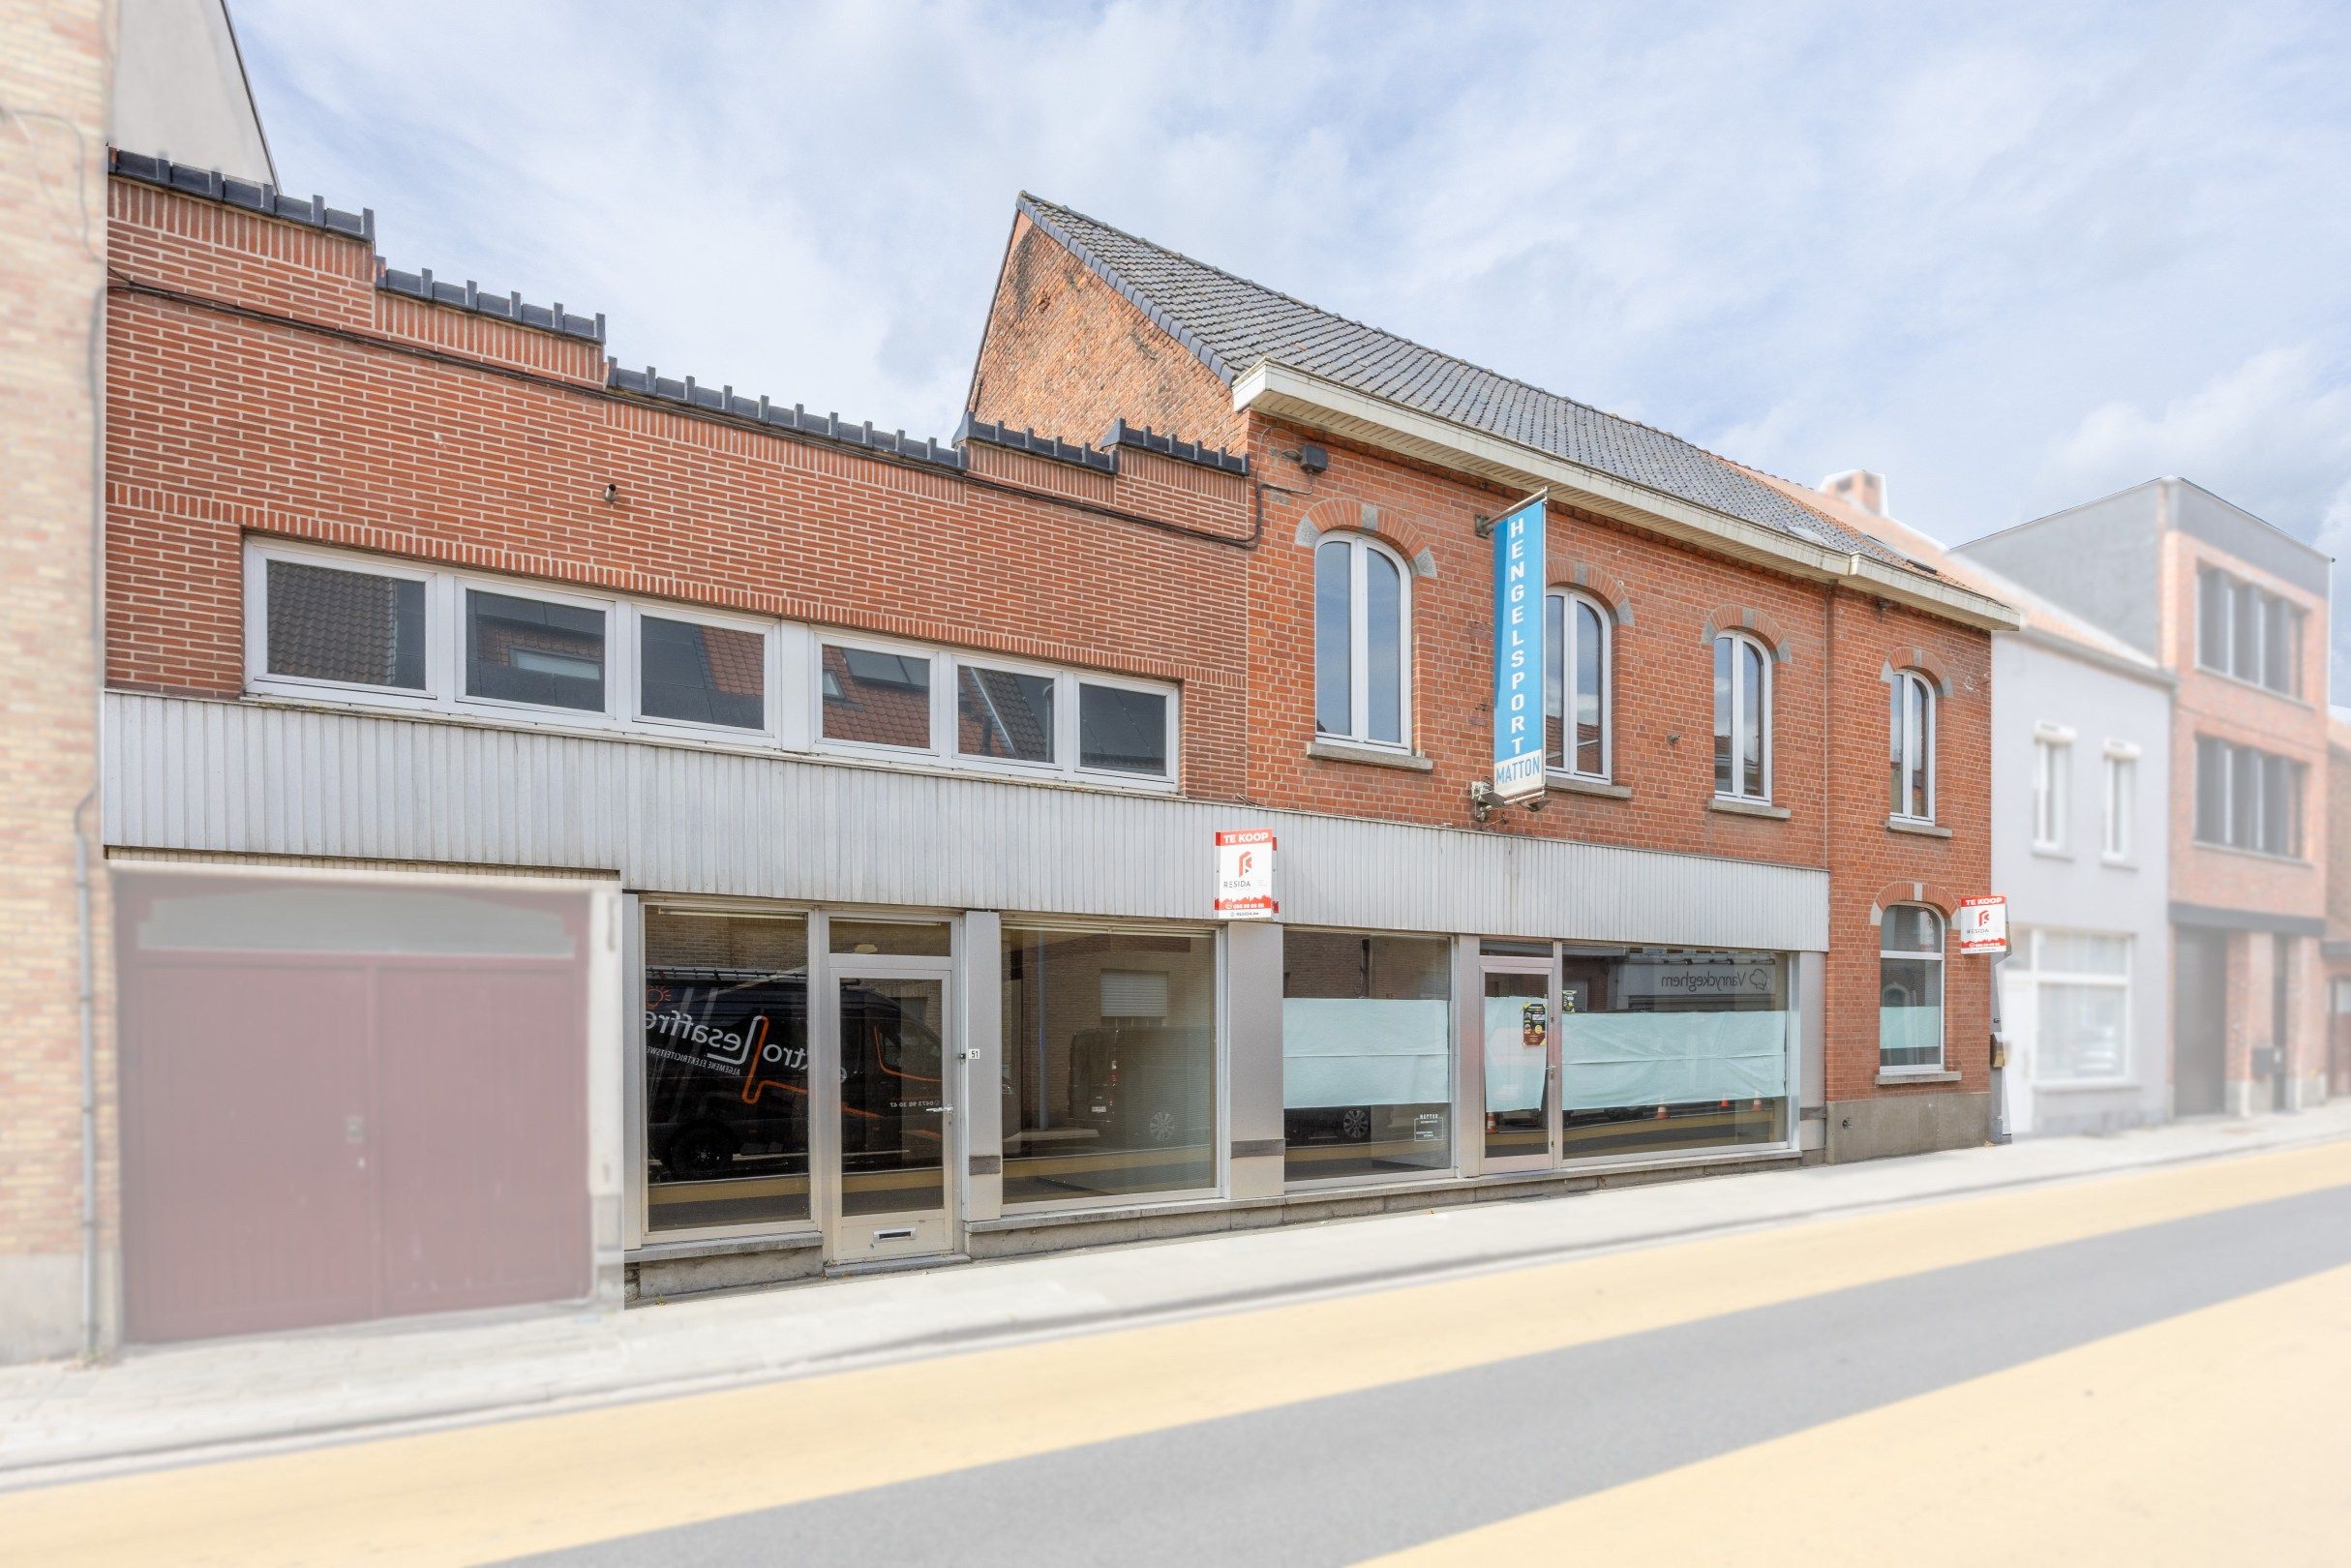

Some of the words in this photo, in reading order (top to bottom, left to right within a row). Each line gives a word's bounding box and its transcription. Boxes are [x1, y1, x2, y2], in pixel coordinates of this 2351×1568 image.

[1510, 517, 1525, 755] HENGELSPORT
[1496, 755, 1540, 785] MATTON
[1222, 834, 1236, 844] TE
[1239, 831, 1269, 843] KOOP
[1222, 880, 1251, 889] RESIDA
[1977, 896, 2003, 905] KOOP
[971, 1050, 979, 1059] 51
